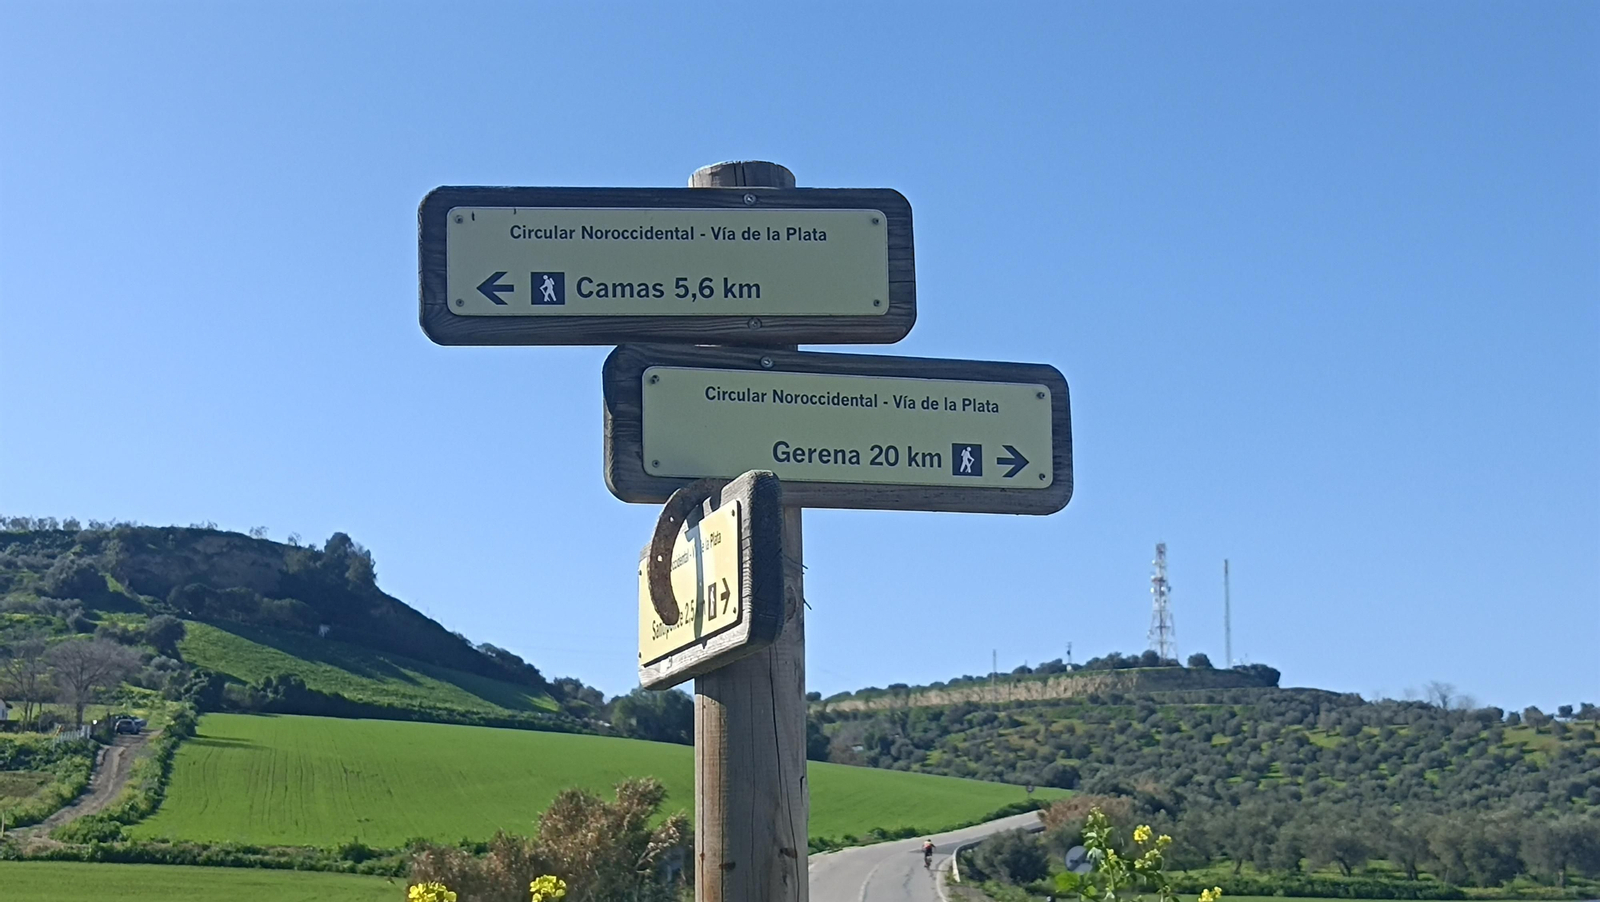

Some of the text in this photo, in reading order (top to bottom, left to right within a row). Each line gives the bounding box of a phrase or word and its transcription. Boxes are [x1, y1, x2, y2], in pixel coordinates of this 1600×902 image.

[510, 224, 575, 240] Circular
[581, 225, 694, 241] Noroccidental
[710, 225, 736, 241] Vía
[741, 226, 761, 241] de
[766, 226, 780, 241] la
[786, 226, 827, 242] Plata
[576, 276, 761, 303] Camas 5,6 km
[705, 385, 767, 403] Circular
[772, 389, 878, 408] Noroccidental
[892, 393, 916, 410] Vía
[920, 395, 939, 411] de
[944, 396, 957, 411] la
[963, 396, 1000, 413] Plata
[772, 440, 942, 468] Gerena 20 km
[671, 548, 689, 570] ccidental
[710, 530, 721, 548] Plata
[685, 599, 694, 626] 2,5
